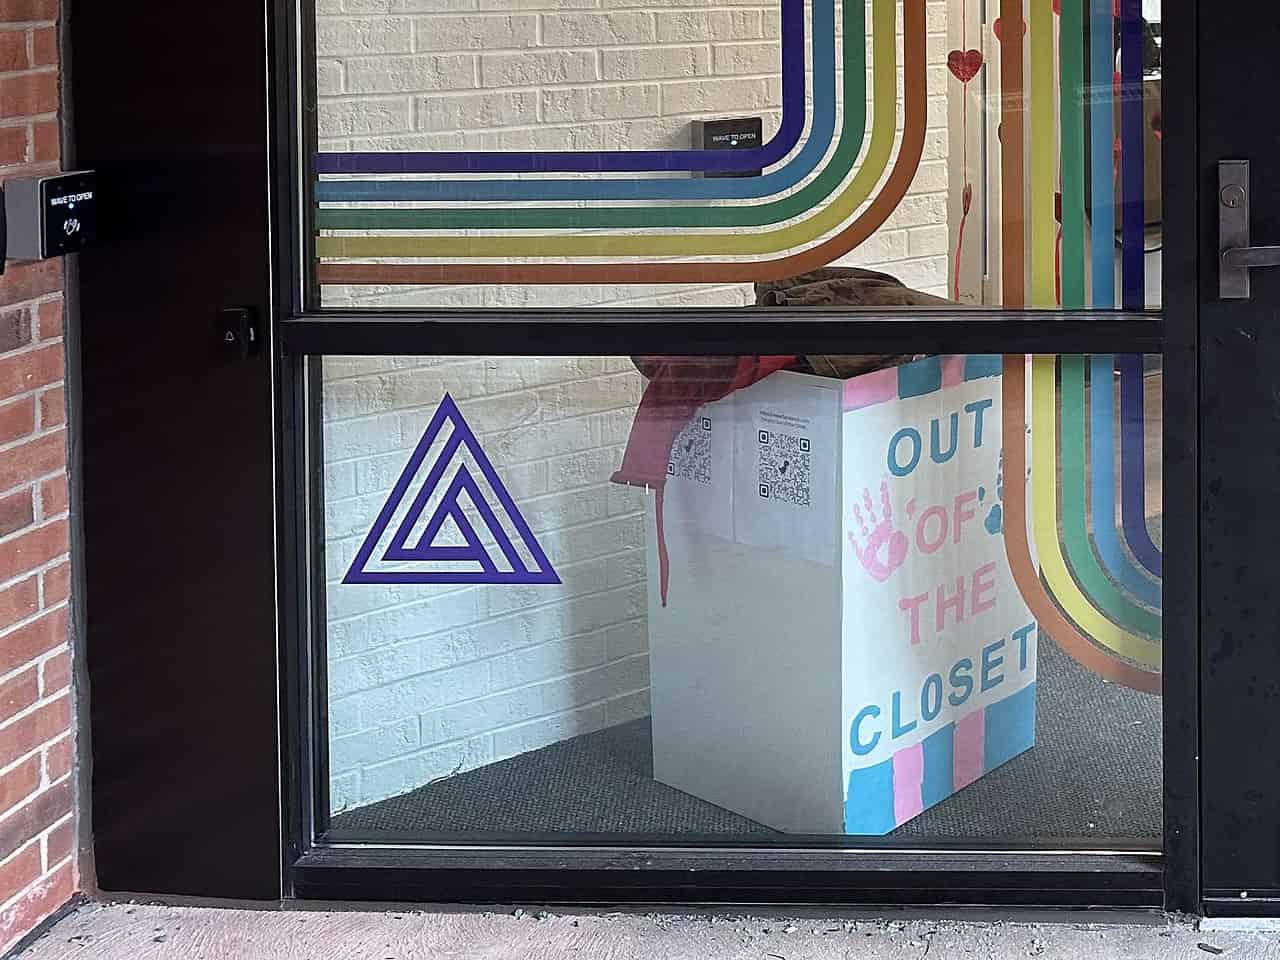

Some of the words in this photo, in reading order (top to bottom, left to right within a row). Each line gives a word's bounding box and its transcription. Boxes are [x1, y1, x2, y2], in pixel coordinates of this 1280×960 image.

[886, 398, 993, 477] OUT
[897, 560, 997, 646] THE
[849, 621, 1036, 757] CLOSET
